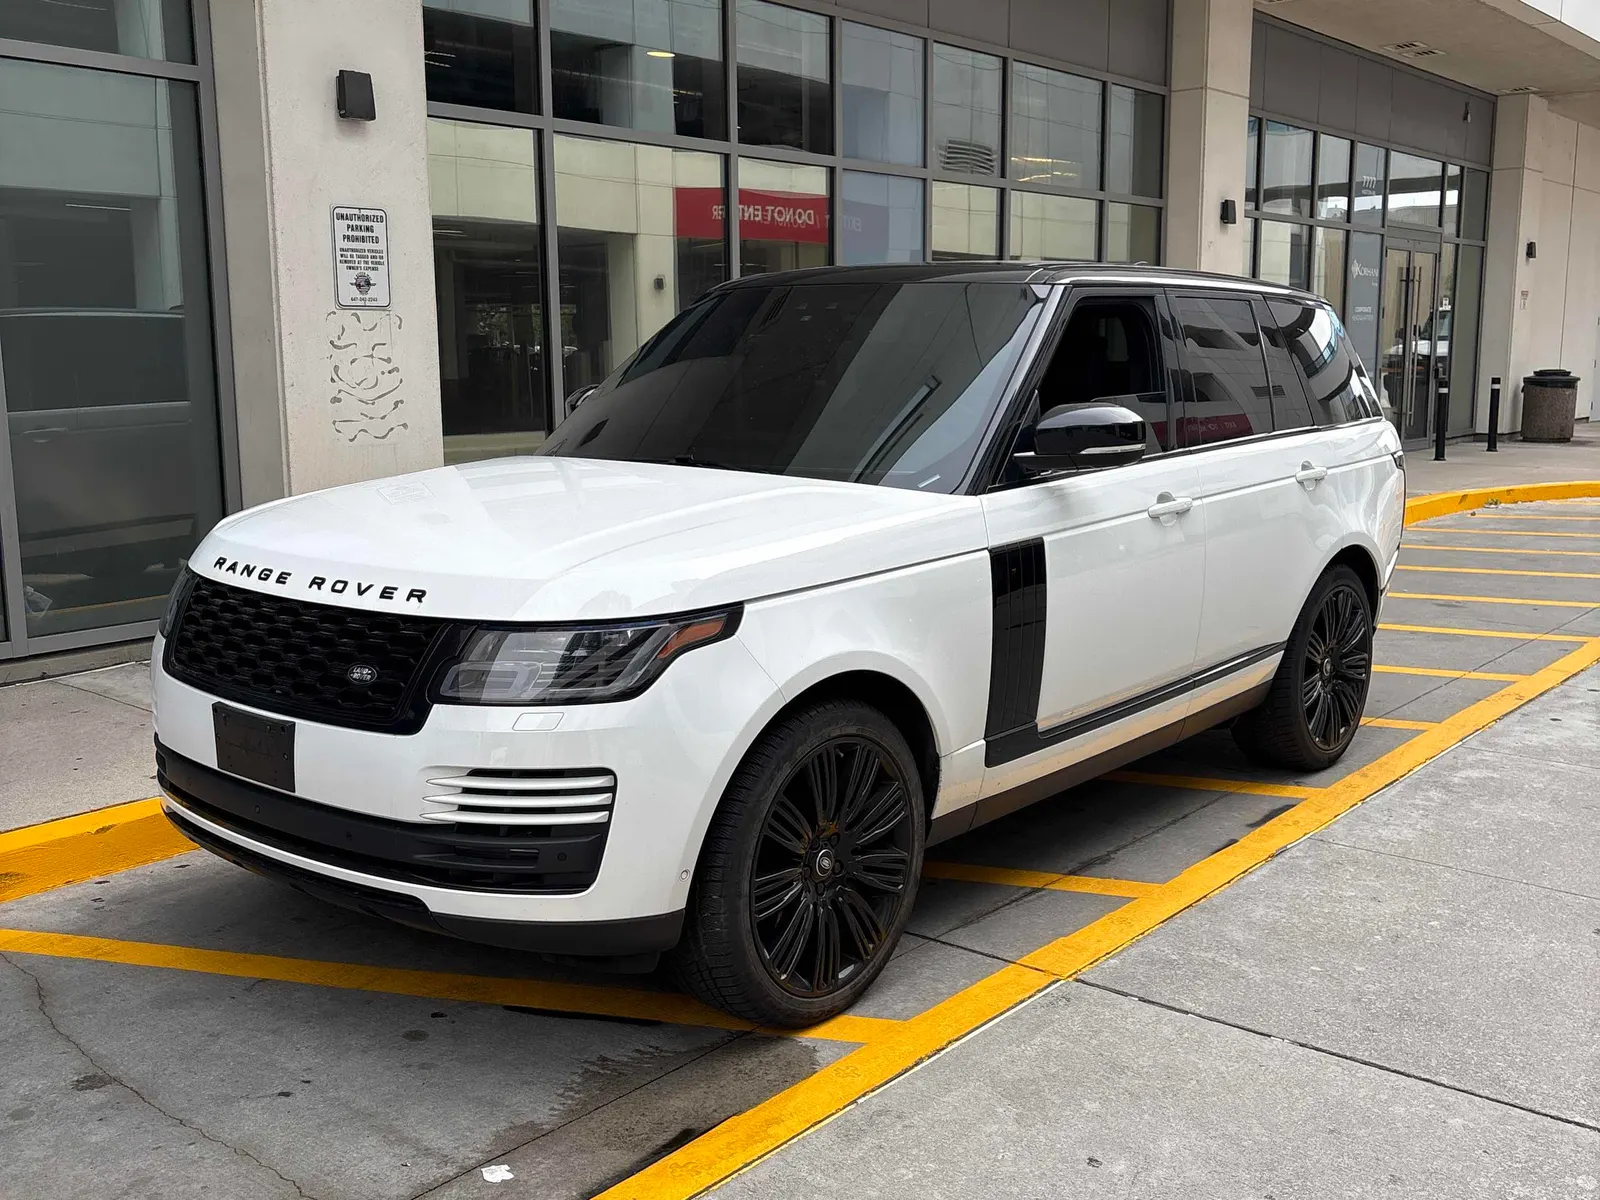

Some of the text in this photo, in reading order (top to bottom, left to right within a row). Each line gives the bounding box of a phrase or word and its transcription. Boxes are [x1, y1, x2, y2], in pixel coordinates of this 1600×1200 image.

[336, 212, 384, 223] UNAUTHORIZED
[346, 224, 374, 233] PARKING
[342, 234, 379, 244] PROHIBITED
[213, 556, 427, 603] RANGE ROVER
